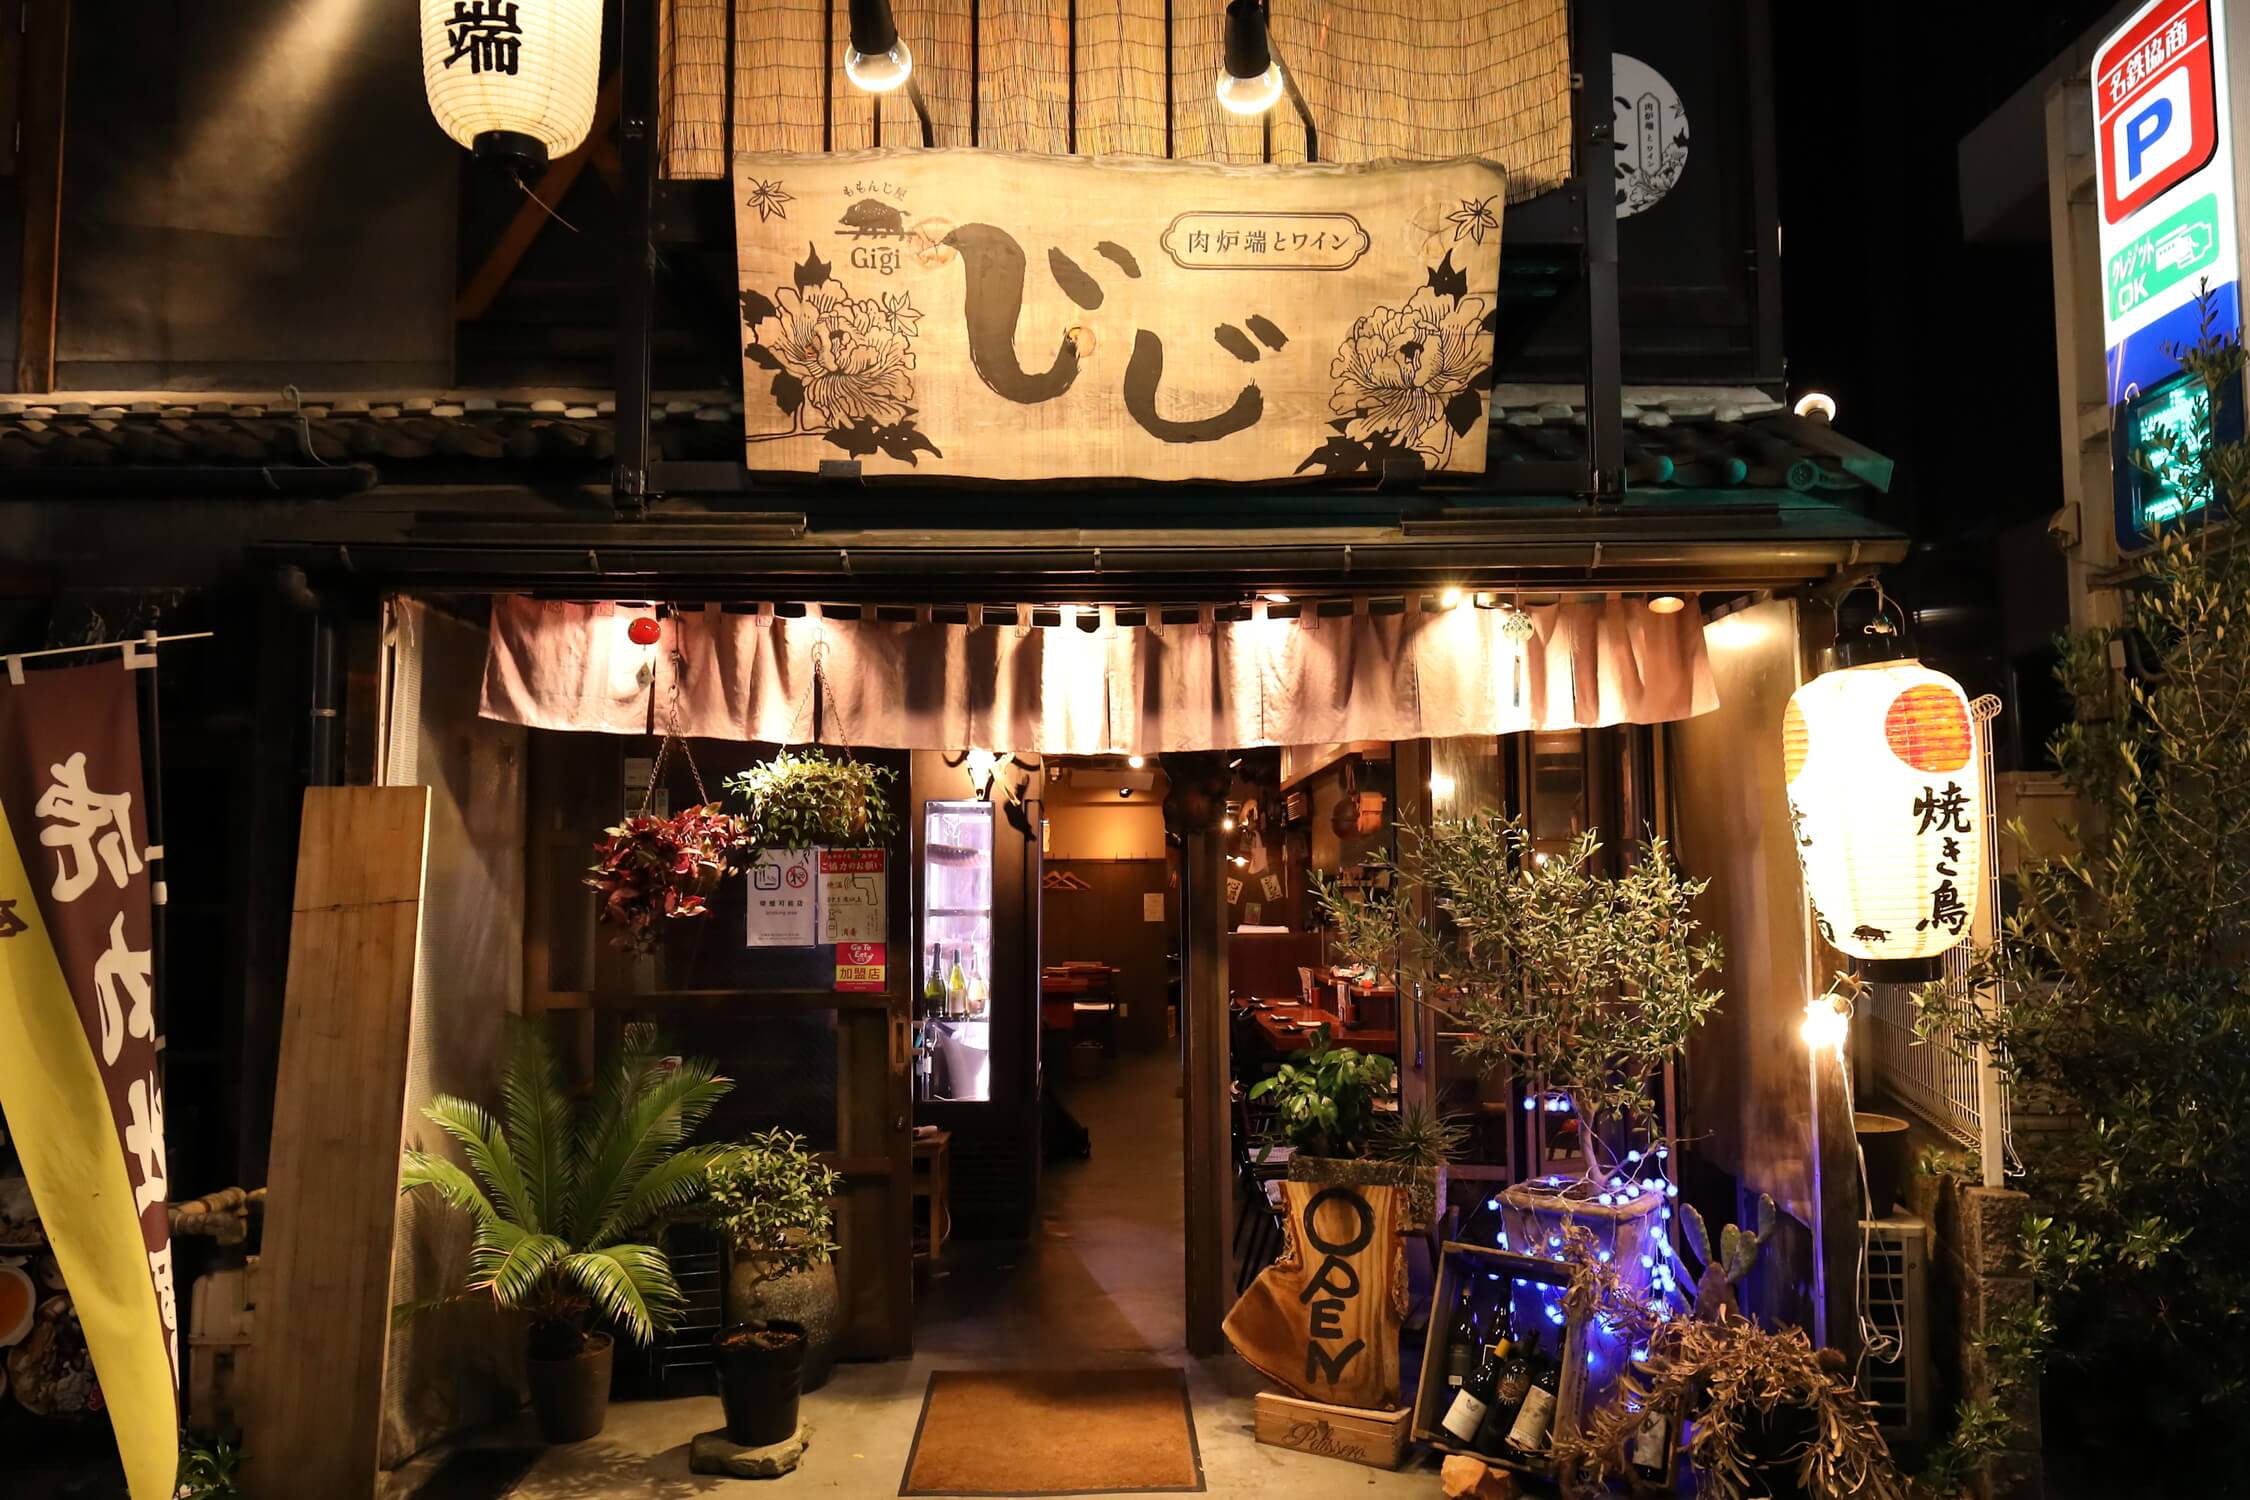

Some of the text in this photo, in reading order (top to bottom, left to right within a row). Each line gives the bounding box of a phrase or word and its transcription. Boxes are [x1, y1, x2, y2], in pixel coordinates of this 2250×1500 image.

[444, 0, 522, 75] 端
[2109, 18, 2188, 103] 名鉄協商
[2126, 97, 2173, 182] P
[850, 246, 902, 276] Gigi
[1188, 229, 1350, 254] 肉炉端とワイン
[2111, 234, 2155, 288] クレジット
[2118, 271, 2150, 313] OK
[1913, 780, 1971, 936] 焼き鳥
[839, 967, 881, 980] 加盟店
[850, 943, 872, 951] Go To
[1303, 1187, 1376, 1385] OPEN
